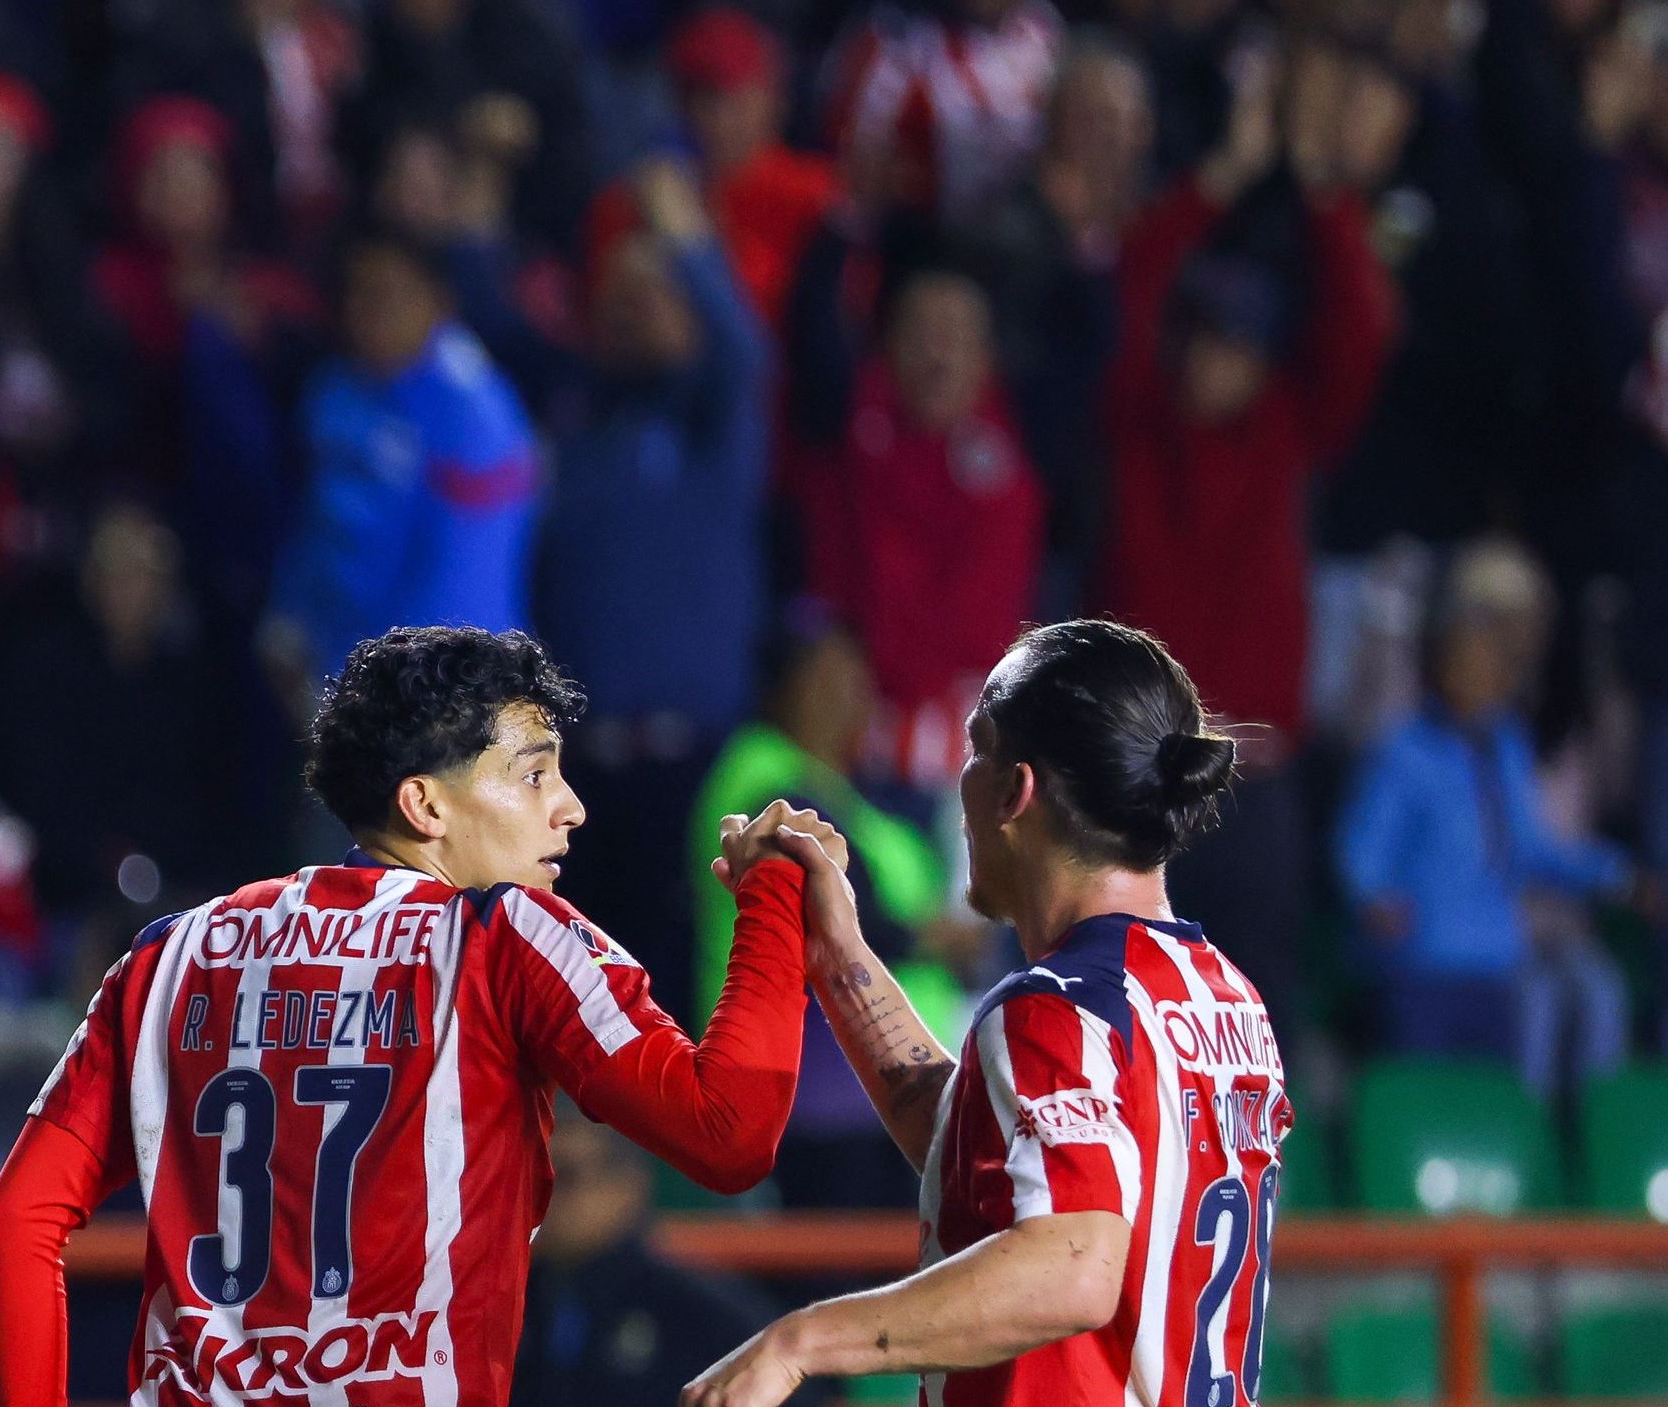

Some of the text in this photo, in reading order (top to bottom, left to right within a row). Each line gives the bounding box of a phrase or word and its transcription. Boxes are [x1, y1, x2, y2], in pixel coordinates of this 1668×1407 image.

[181, 989, 420, 1052] R. LEDEZMA
[1039, 1096, 1108, 1127] GNP
[188, 1065, 393, 1307] 37
